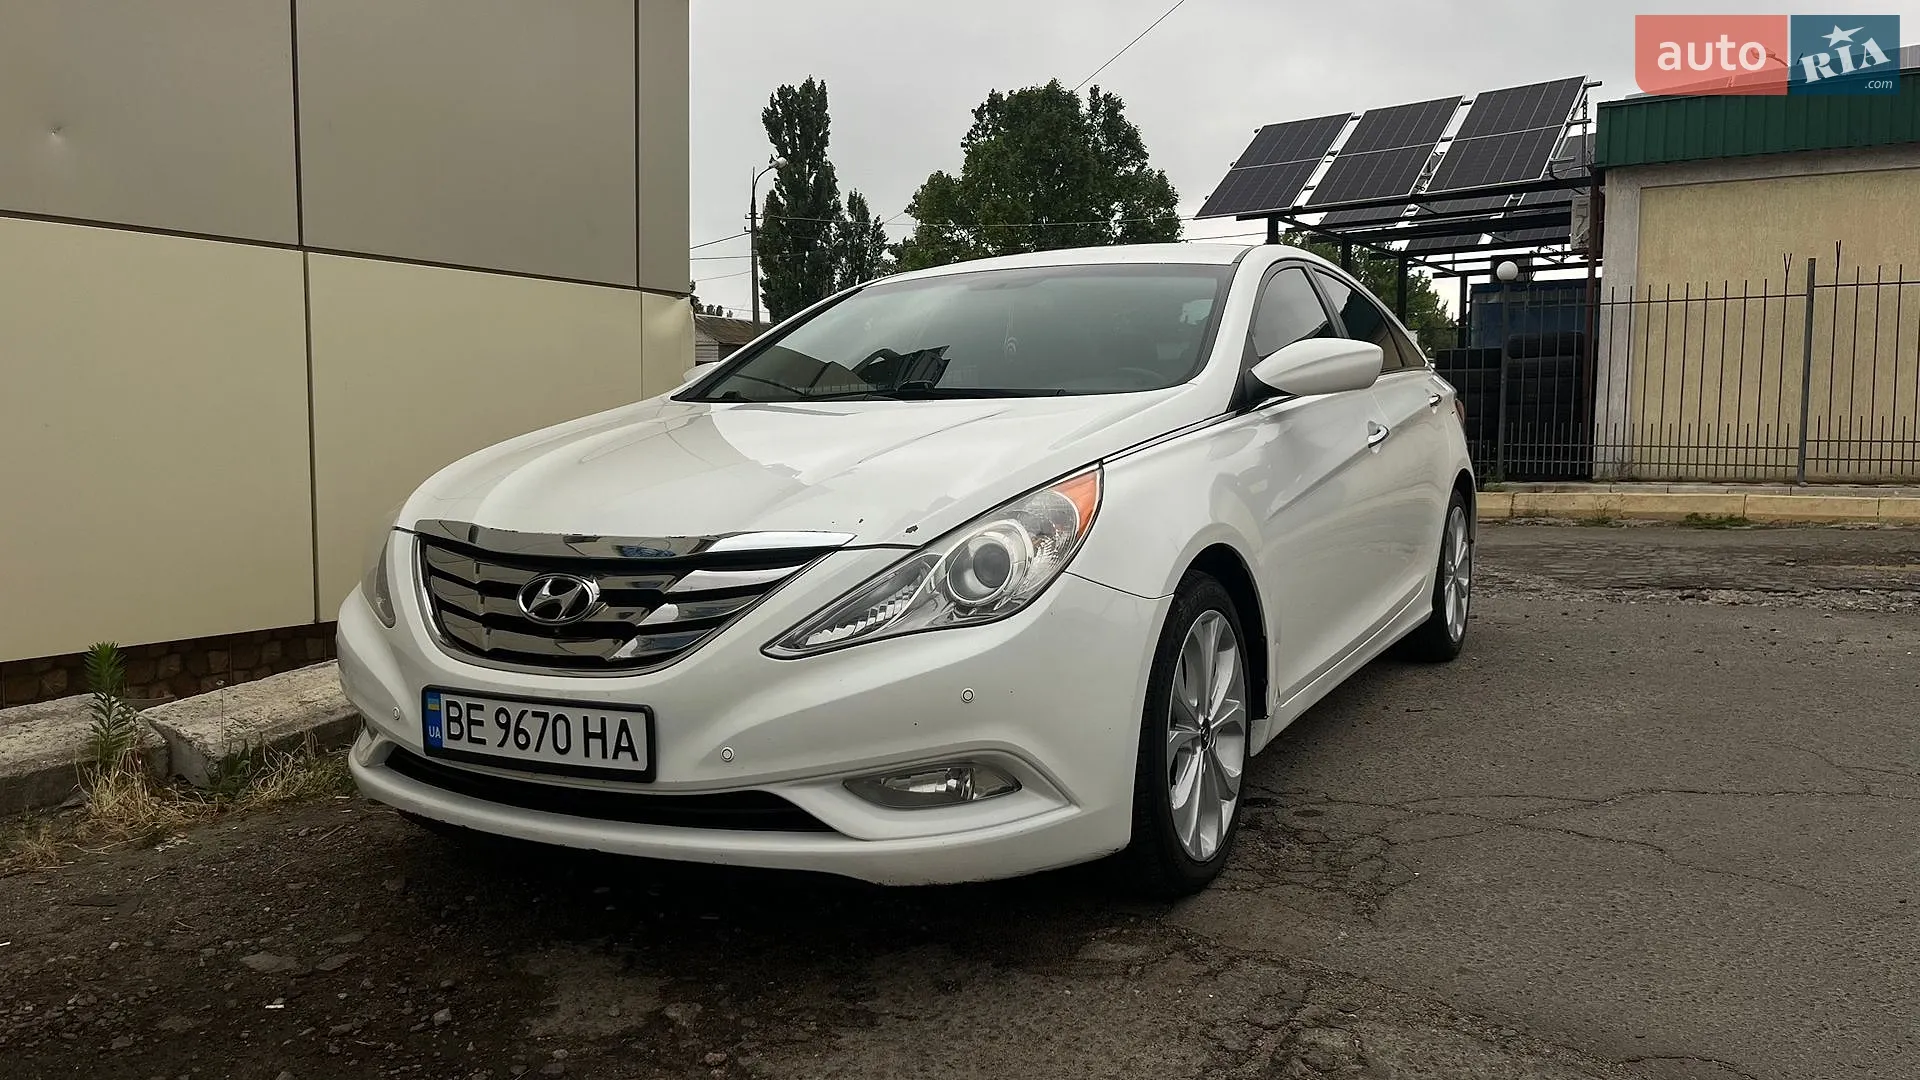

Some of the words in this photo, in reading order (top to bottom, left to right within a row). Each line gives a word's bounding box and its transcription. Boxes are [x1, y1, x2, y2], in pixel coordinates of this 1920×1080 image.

[428, 725, 442, 739] UA
[446, 699, 487, 746] BE
[494, 706, 572, 756] 9670
[582, 715, 639, 762] HA
